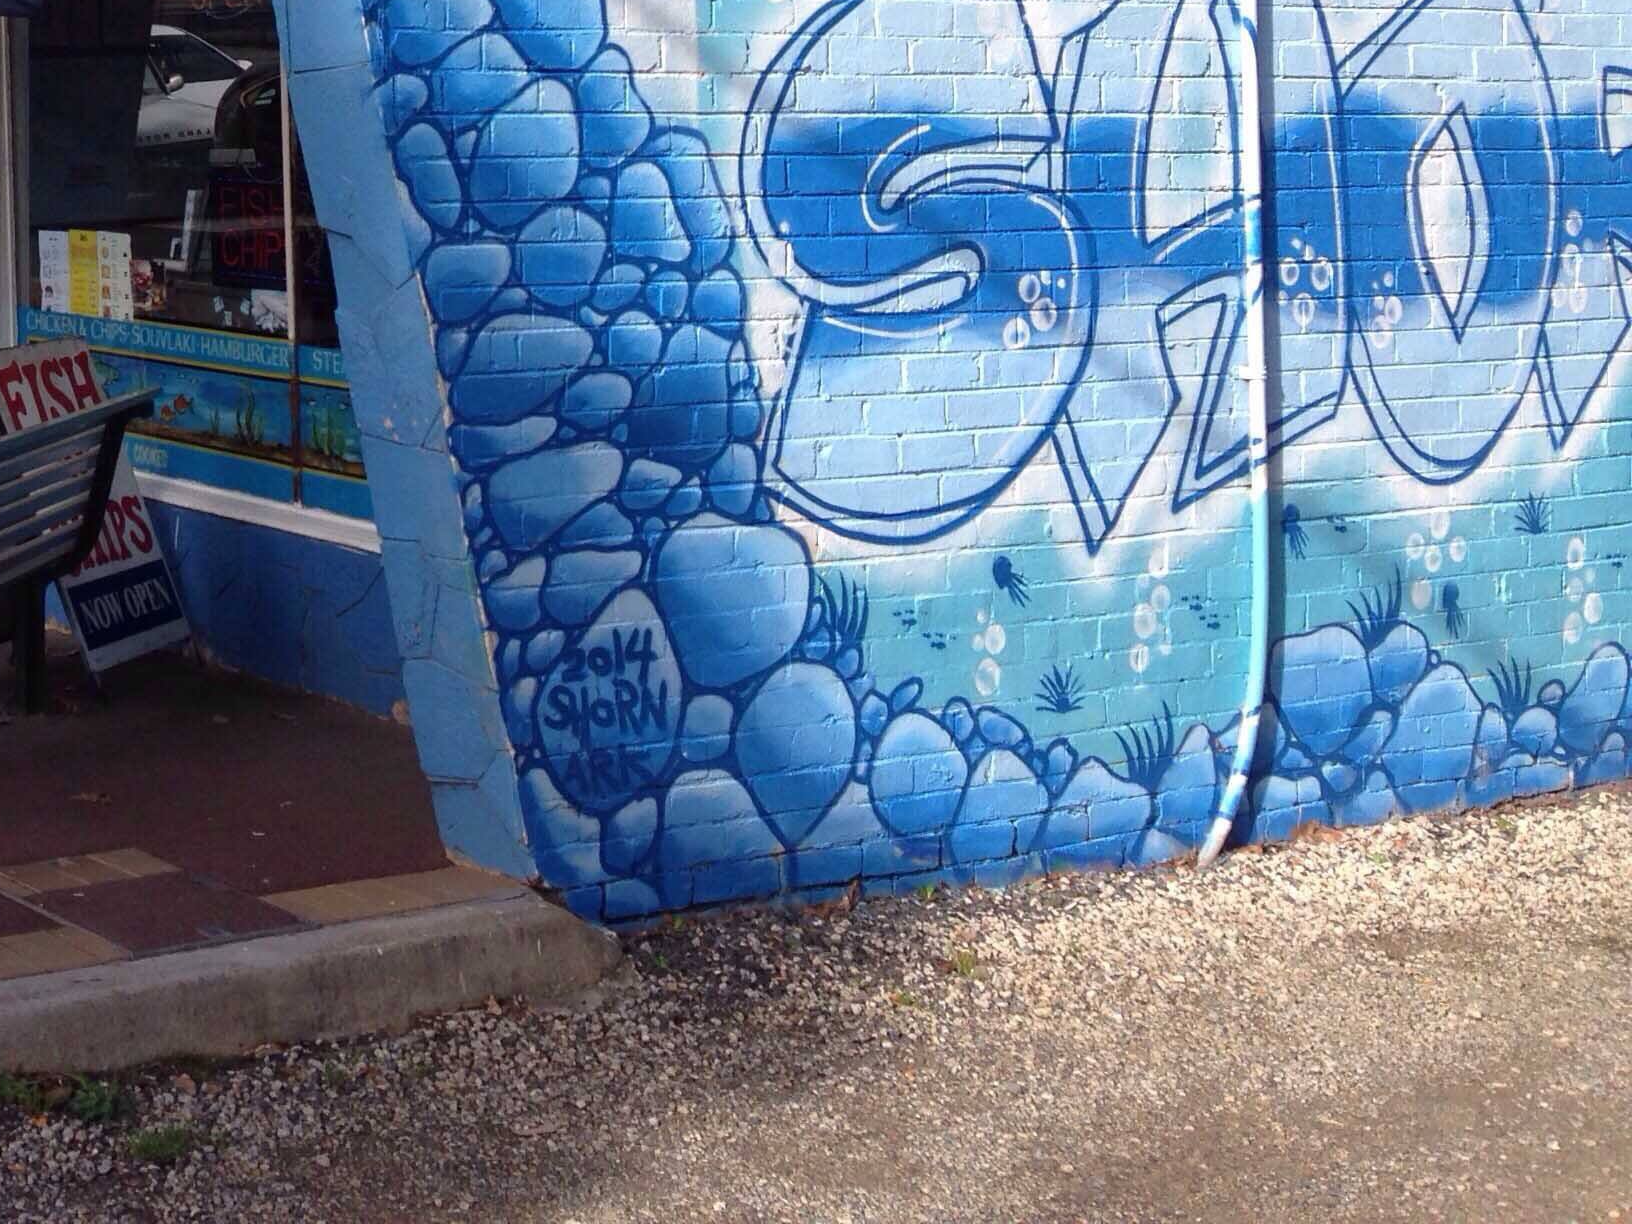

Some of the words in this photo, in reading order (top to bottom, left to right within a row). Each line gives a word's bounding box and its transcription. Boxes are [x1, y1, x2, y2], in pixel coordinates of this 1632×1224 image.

[25, 309, 79, 336] CHICKEN
[311, 351, 343, 377] STE
[79, 586, 124, 633] NOW
[123, 577, 174, 620] OPEN
[562, 627, 658, 682] 2014
